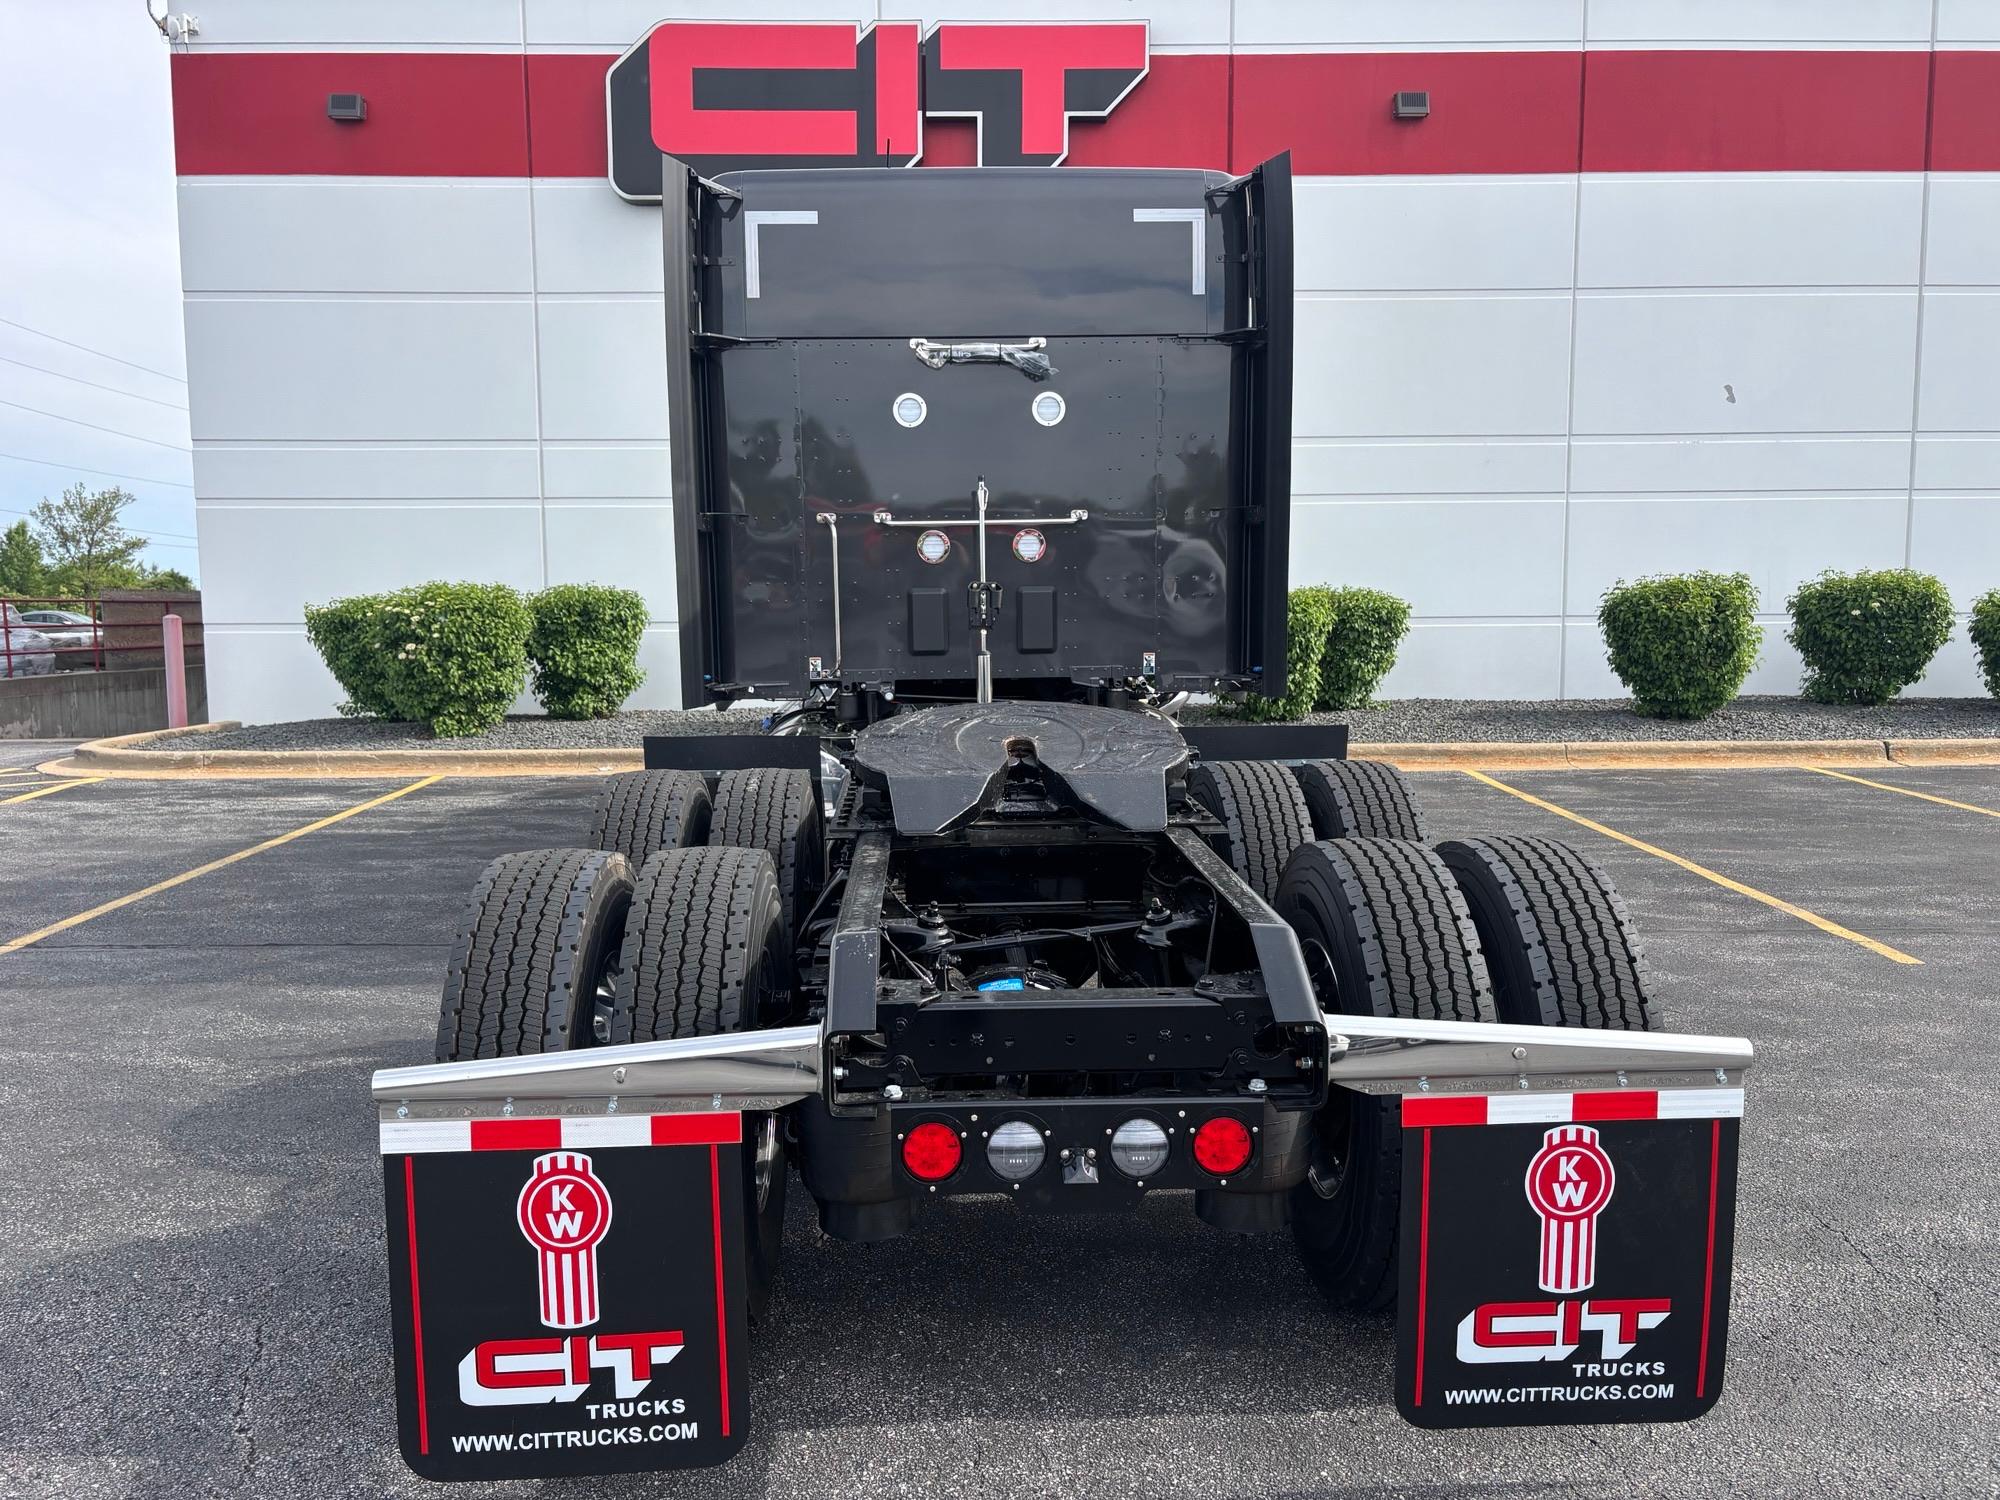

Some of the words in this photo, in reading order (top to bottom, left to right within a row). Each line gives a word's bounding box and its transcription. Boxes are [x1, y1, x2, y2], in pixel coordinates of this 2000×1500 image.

[640, 22, 1148, 160] CIT
[1468, 1298, 1672, 1352] CIT
[468, 1330, 685, 1395] CIT
[1572, 1361, 1666, 1378] TRUCKS
[586, 1398, 686, 1420] TRUCKS
[1445, 1383, 1674, 1405] WWW.CITTRUCKS.COM
[452, 1422, 698, 1453] WWW.CITTRUCKS.COM
